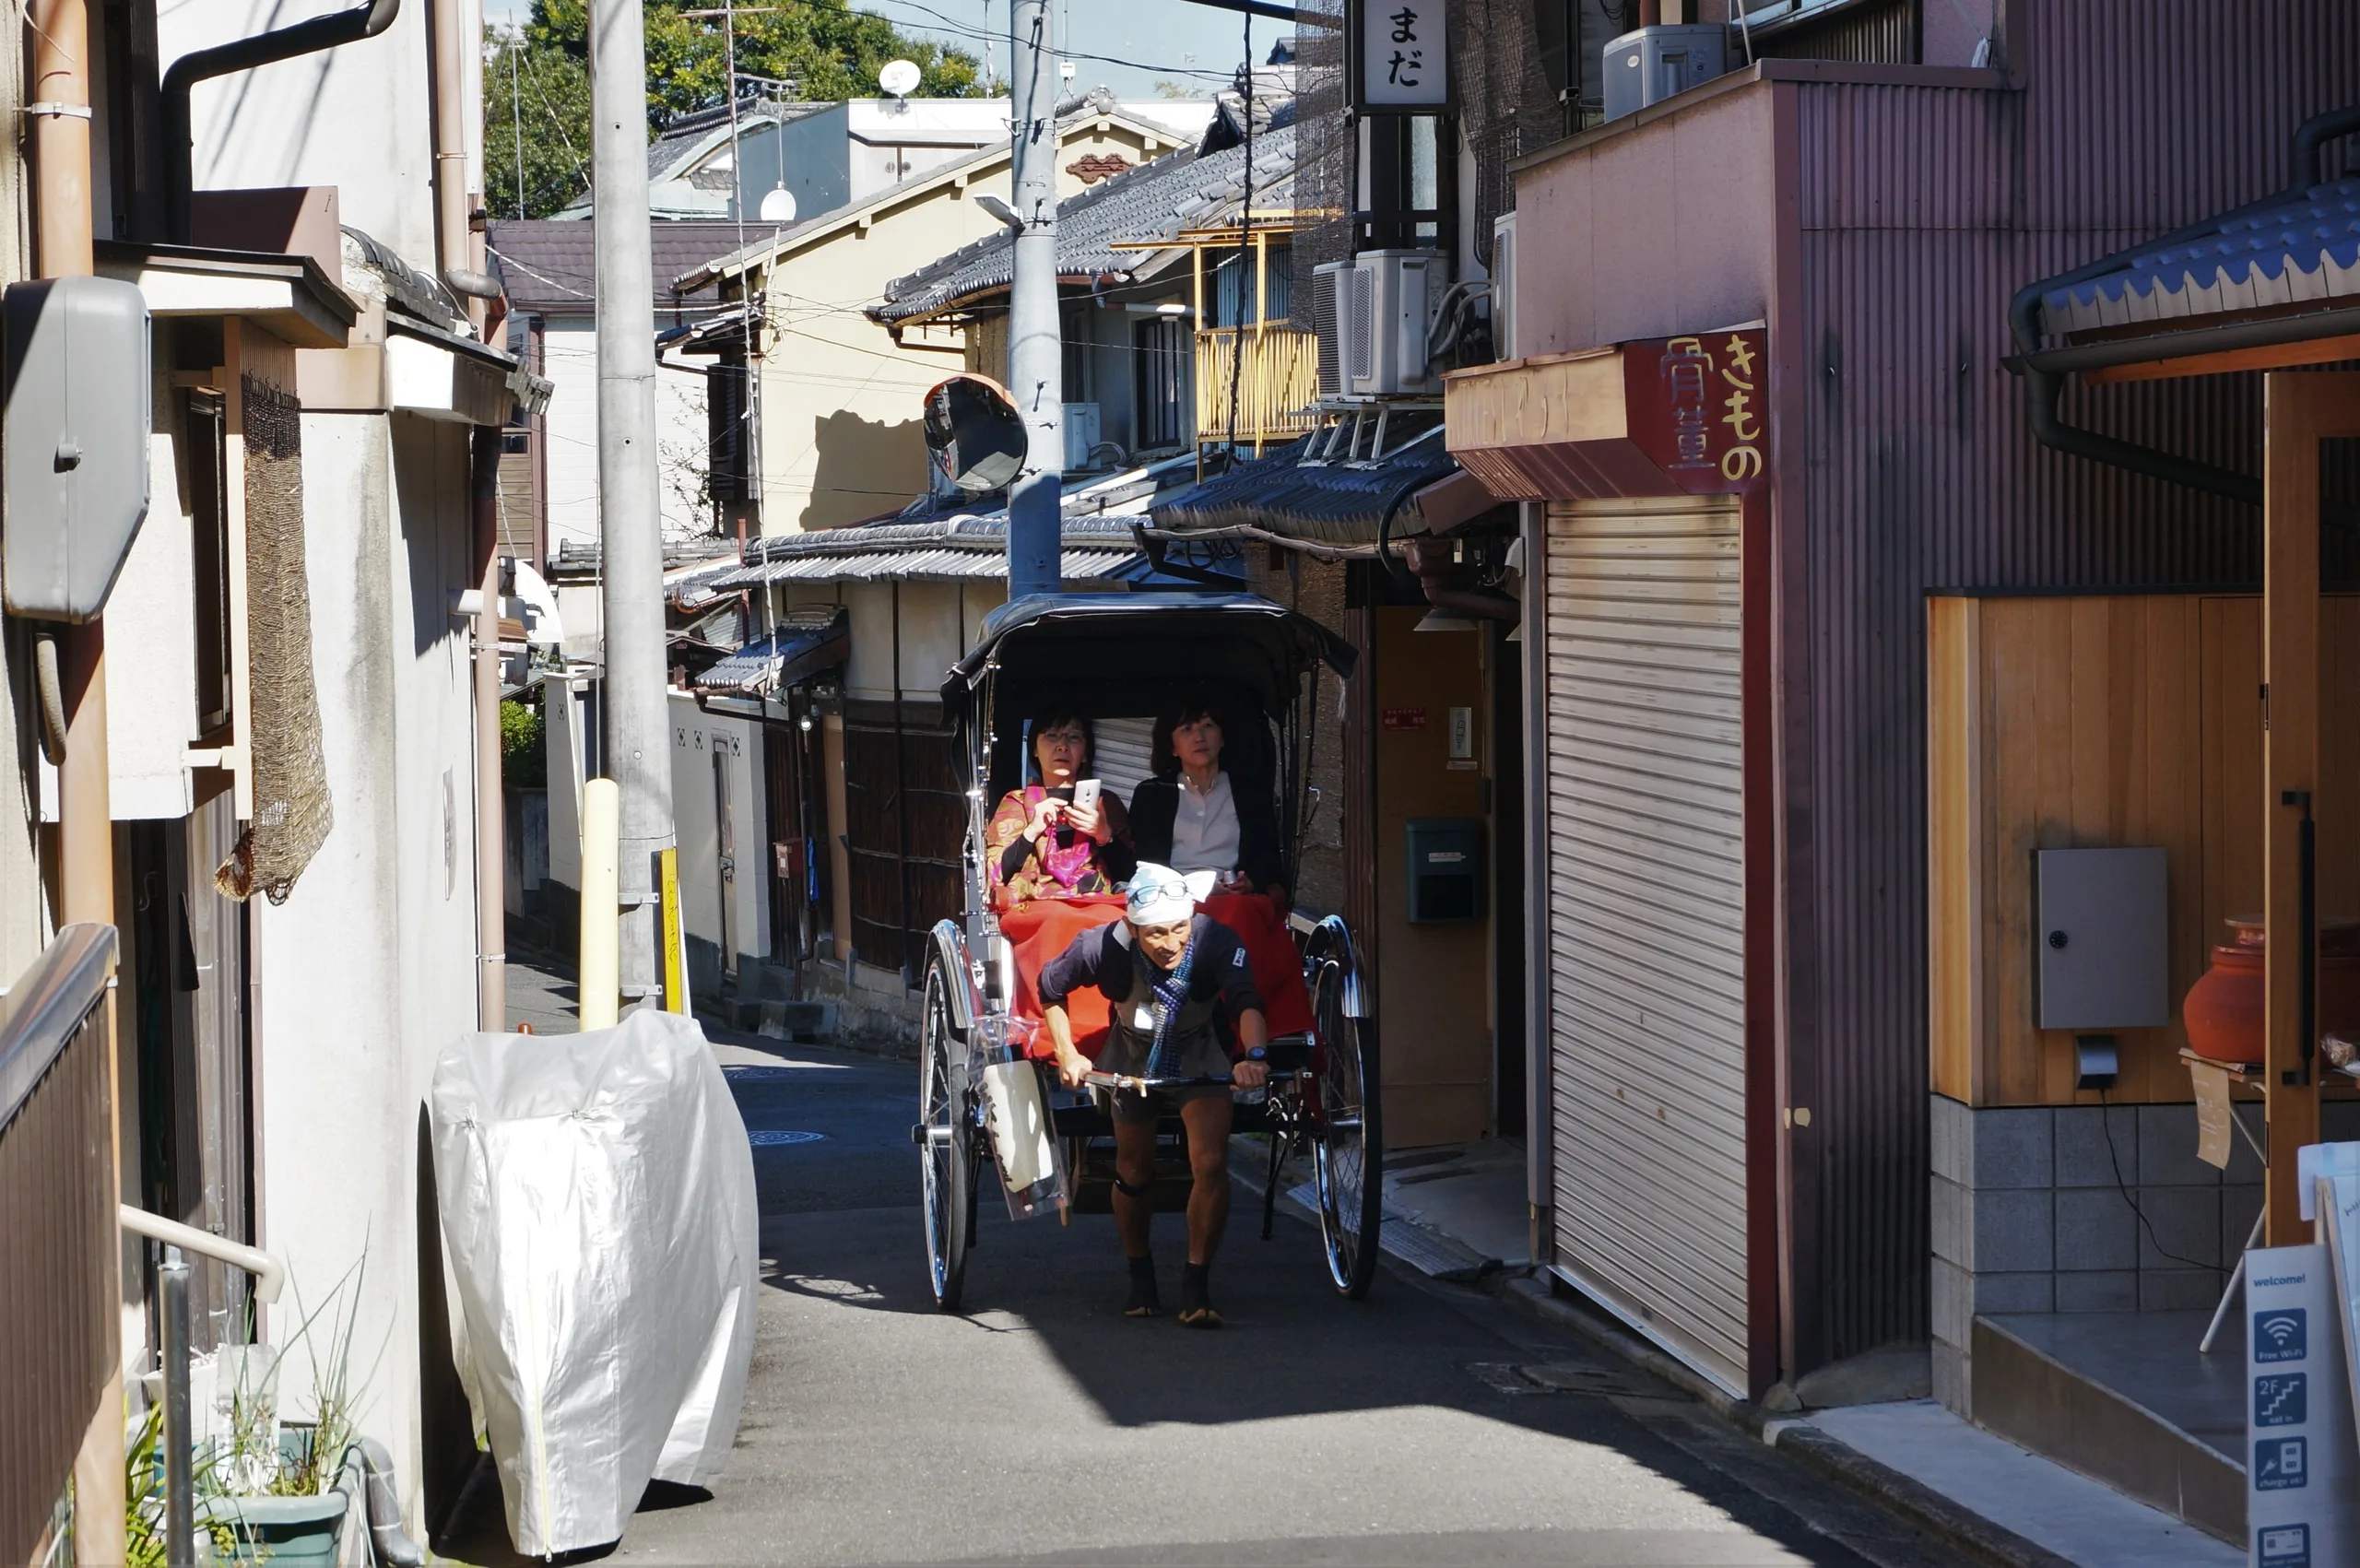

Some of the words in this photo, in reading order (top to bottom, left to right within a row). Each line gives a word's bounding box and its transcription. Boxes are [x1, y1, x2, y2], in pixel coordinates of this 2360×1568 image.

[1659, 337, 1716, 469] 骨董
[1721, 334, 1762, 480] きもの
[2253, 1273, 2306, 1288] welcome!
[2259, 1350, 2278, 1360] Free
[2259, 1379, 2279, 1395] 2F
[2269, 1415, 2283, 1423] eat
[2284, 1414, 2294, 1422] in
